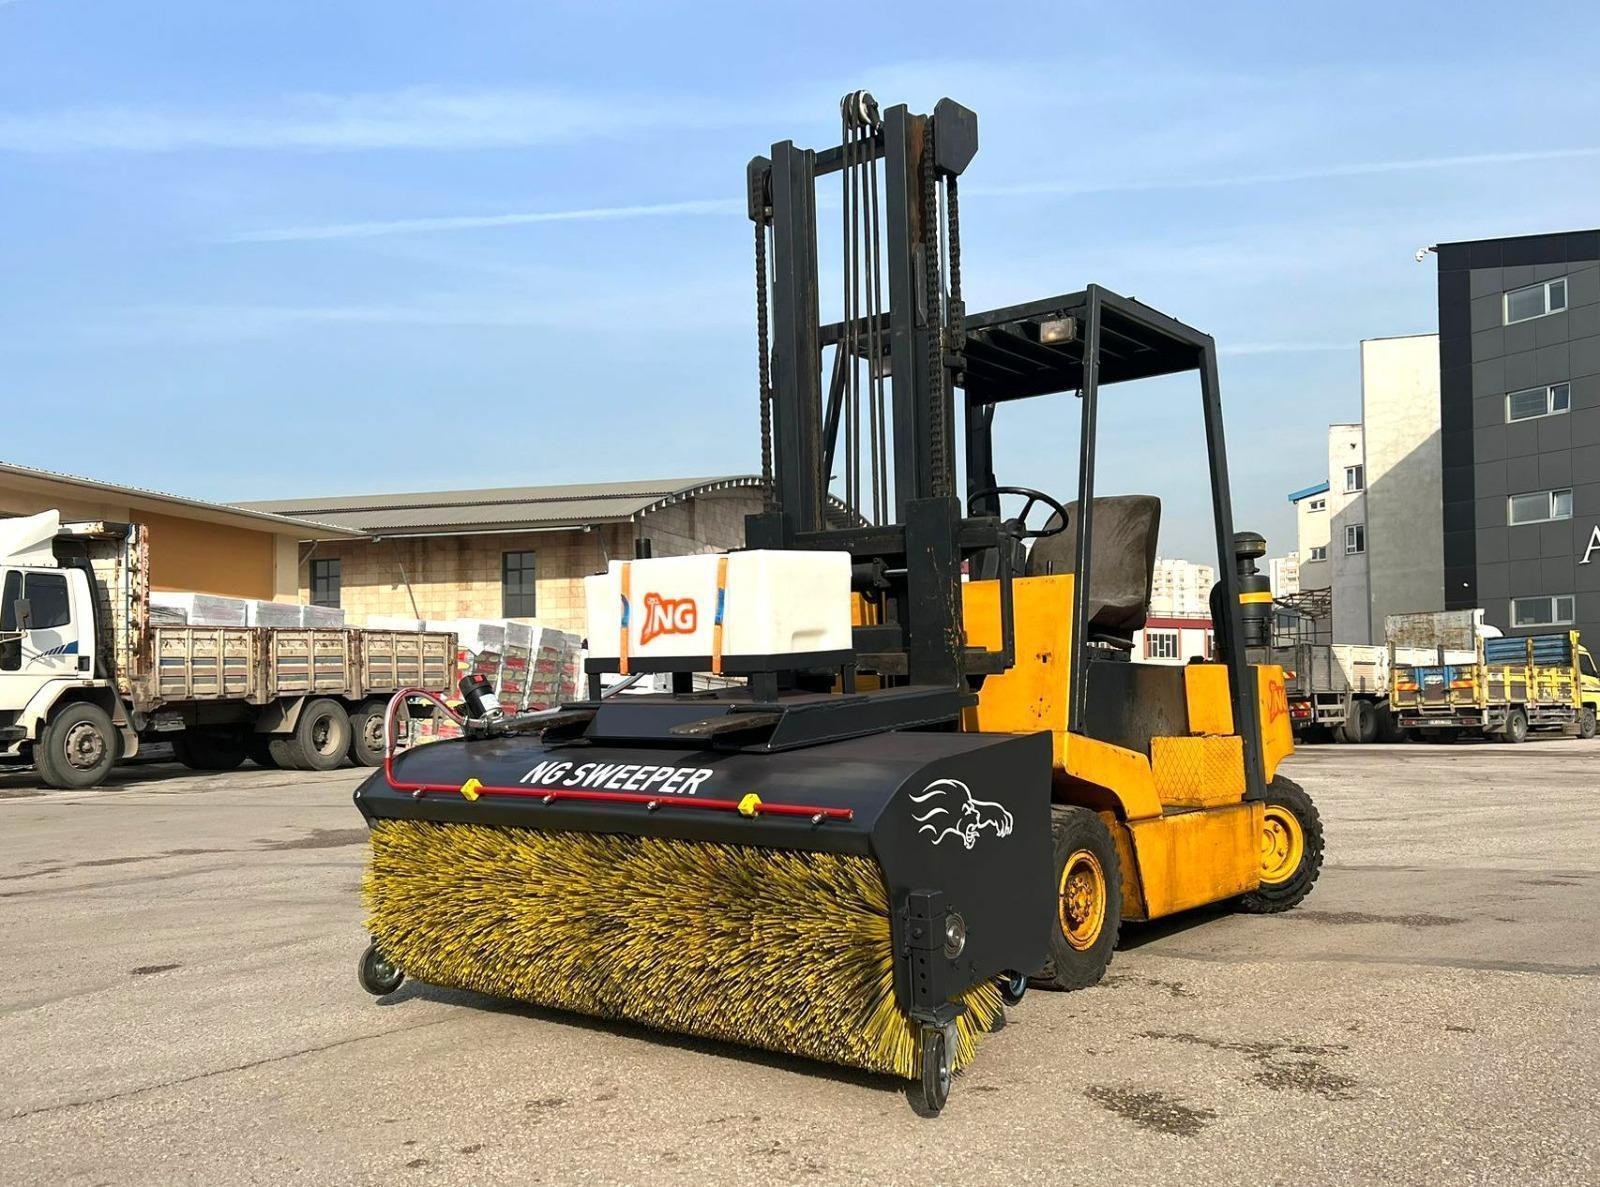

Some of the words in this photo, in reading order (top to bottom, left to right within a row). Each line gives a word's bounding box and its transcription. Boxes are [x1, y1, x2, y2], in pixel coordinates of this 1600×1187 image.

[1578, 525, 1600, 564] A
[648, 598, 697, 635] NG
[520, 761, 573, 784] NG
[562, 763, 714, 794] SWEEPER
